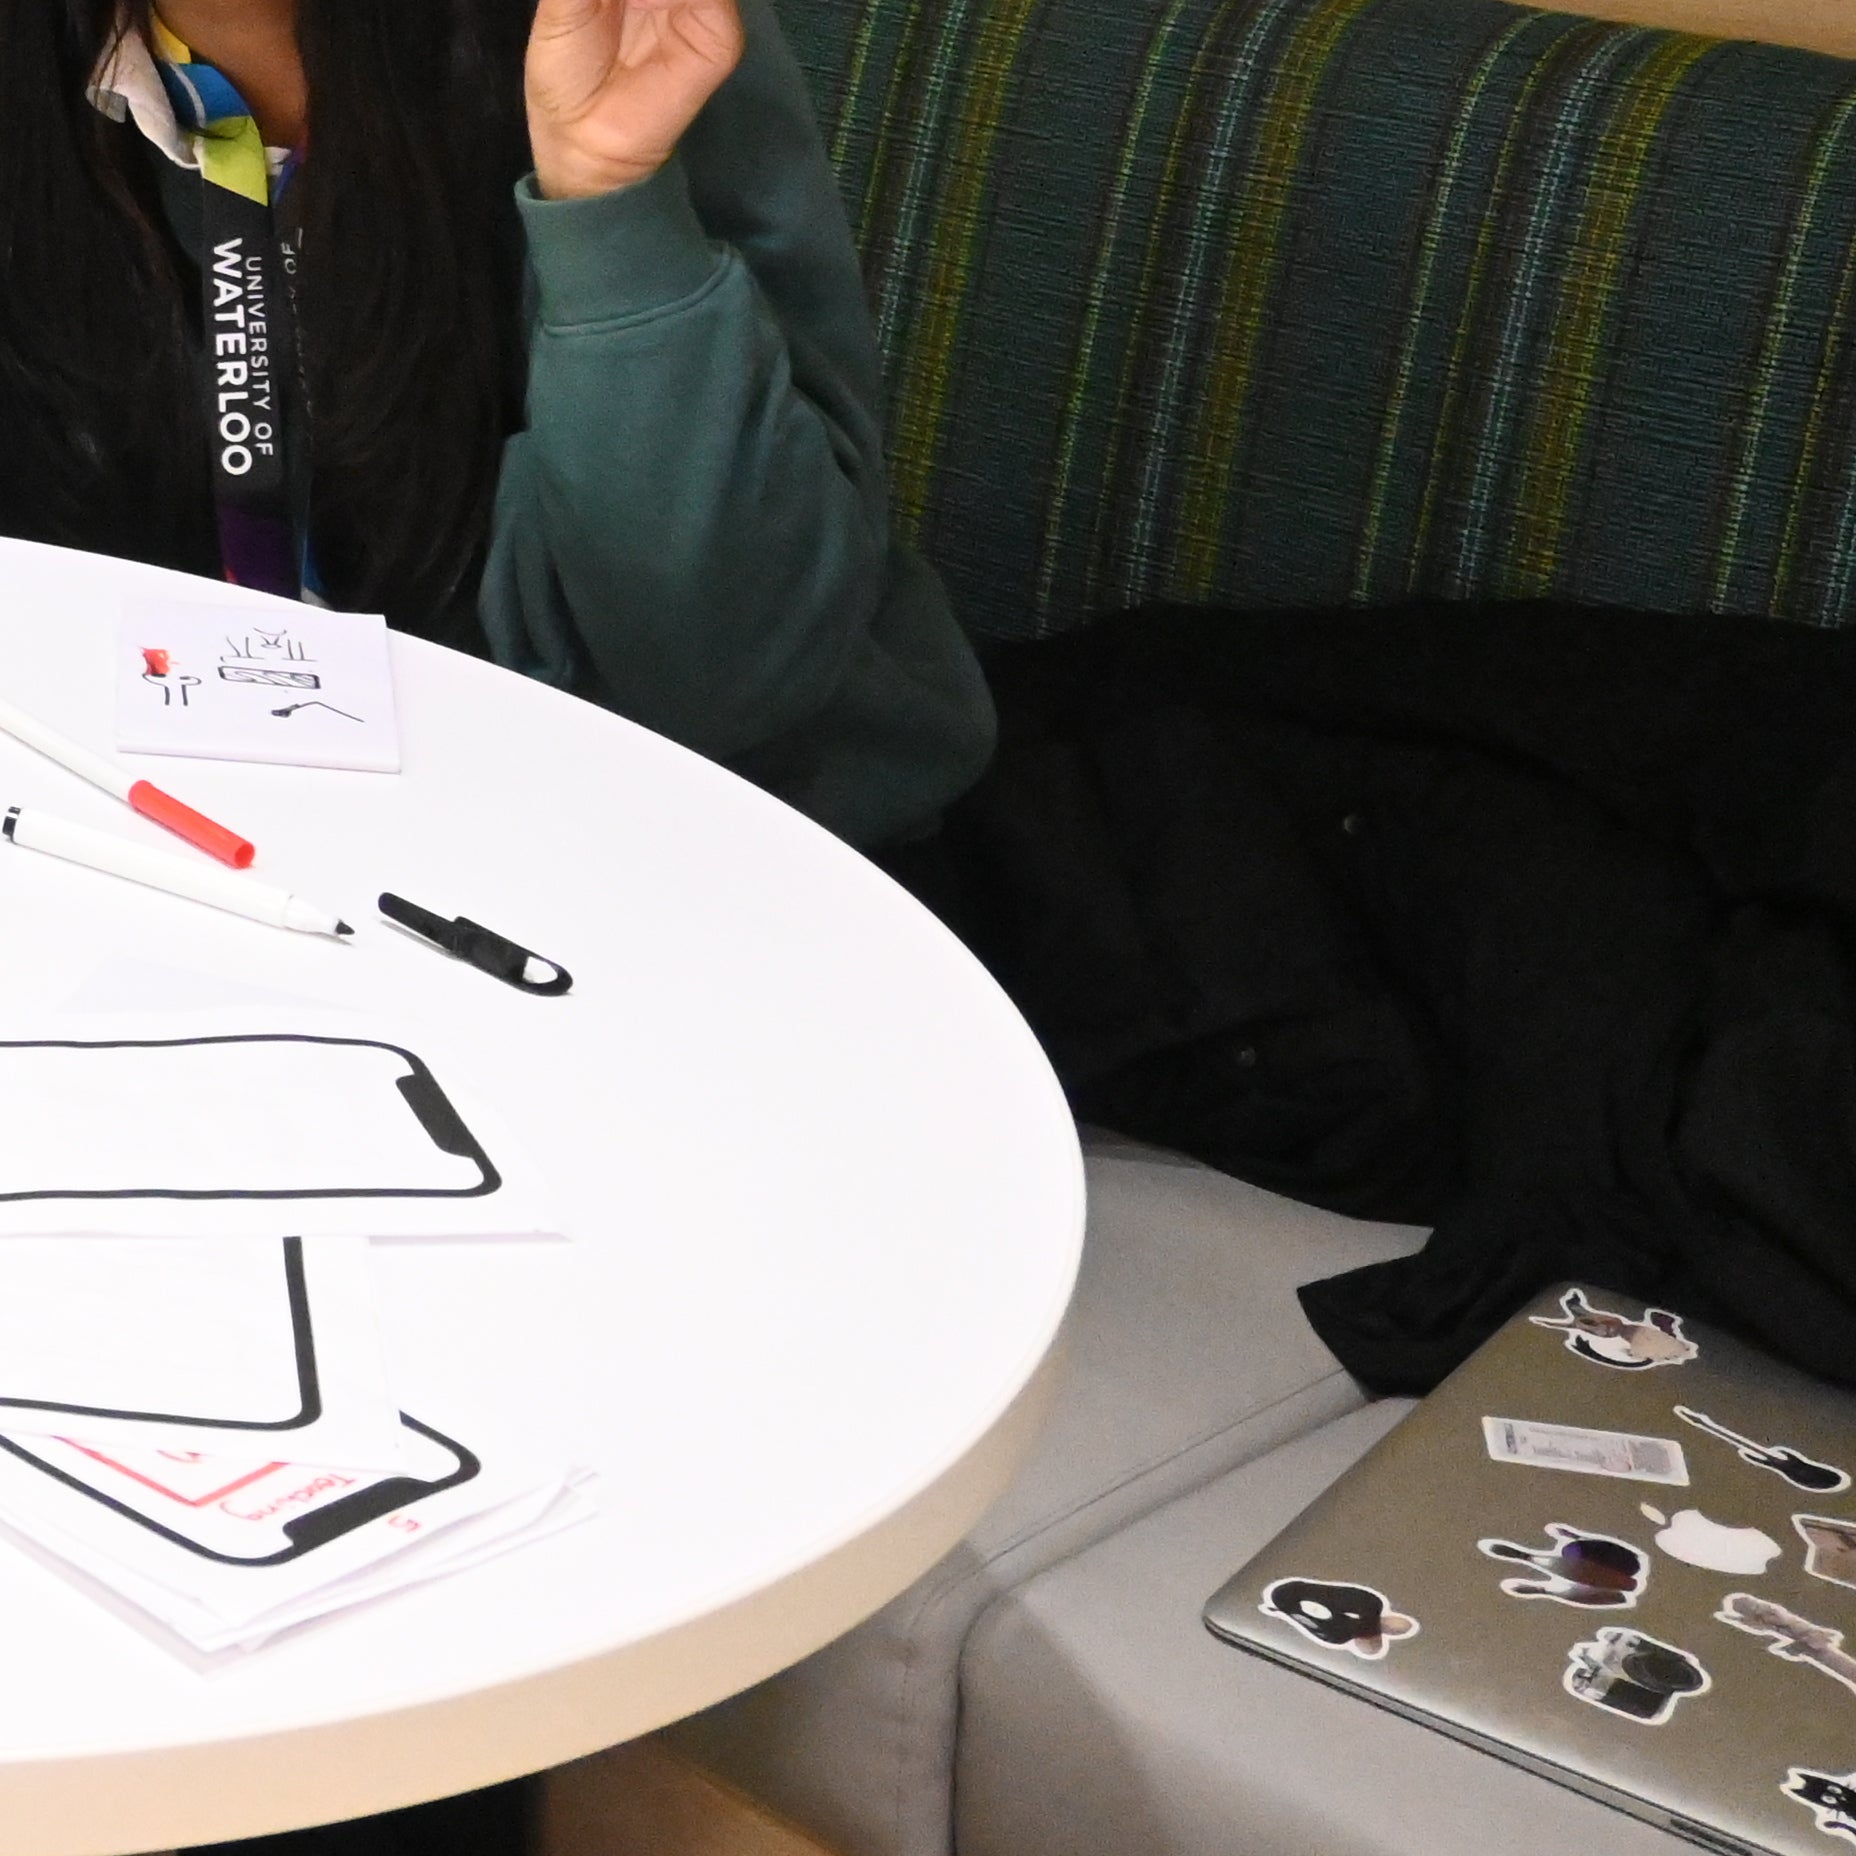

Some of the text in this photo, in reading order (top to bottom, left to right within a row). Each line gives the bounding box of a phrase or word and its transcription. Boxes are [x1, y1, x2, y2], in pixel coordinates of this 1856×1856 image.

[212, 237, 253, 476] WATERLOO
[245, 256, 274, 456] UNIVERSITY OF
